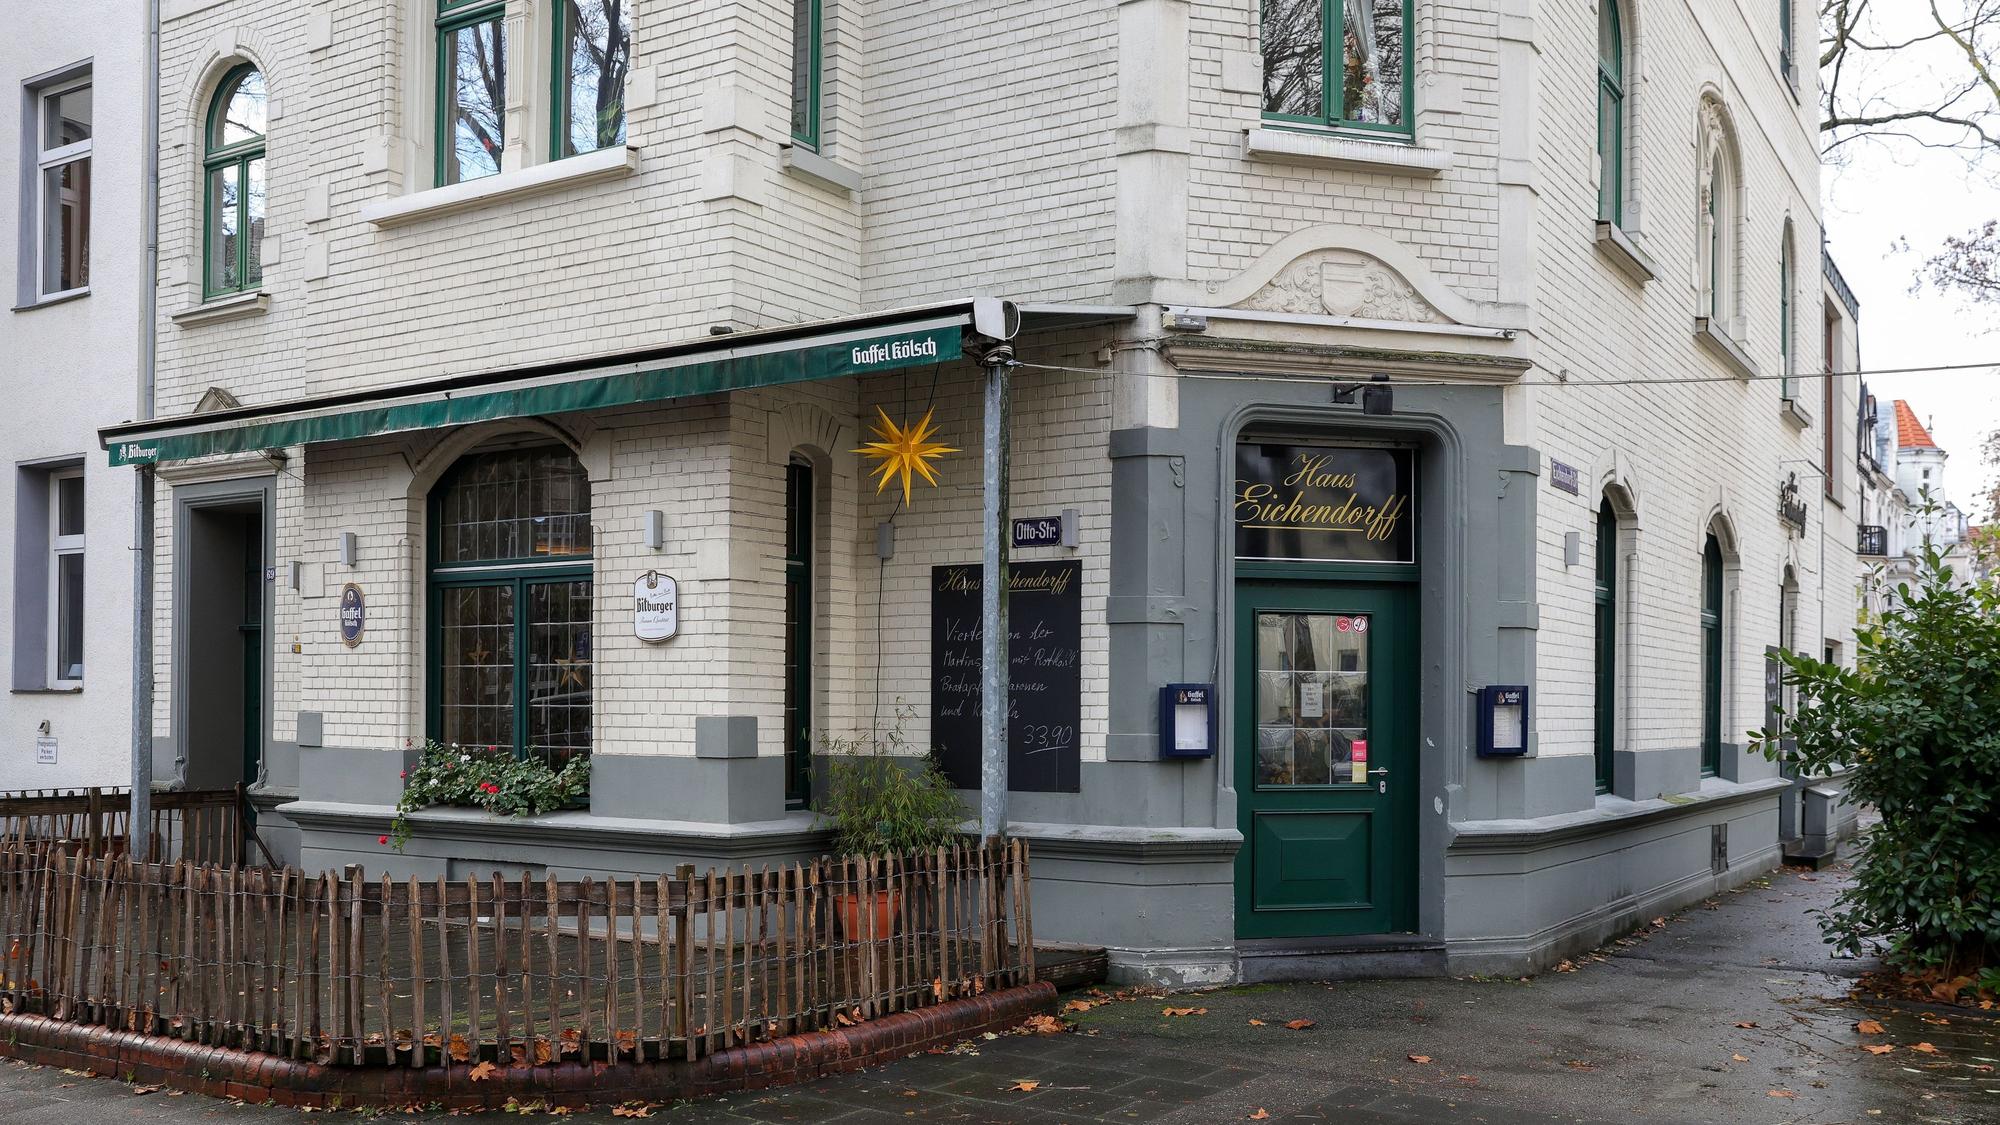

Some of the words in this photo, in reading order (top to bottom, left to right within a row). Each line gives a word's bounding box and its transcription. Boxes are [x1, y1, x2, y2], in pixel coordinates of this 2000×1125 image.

[852, 342, 891, 365] Gaffel
[891, 336, 937, 360] Kölsch
[127, 443, 157, 459] Bitburger
[1284, 452, 1357, 489] Haus
[1235, 480, 1407, 541] Eichendorff
[1016, 521, 1057, 540] Otto-Str.
[939, 568, 981, 592] Haus
[1008, 568, 1073, 595] hendorff
[341, 607, 362, 620] Gaffel
[636, 598, 674, 614] Bitburger
[946, 615, 983, 641] Vierte
[1007, 675, 1048, 692] aronen
[1023, 725, 1073, 748] 33,90
